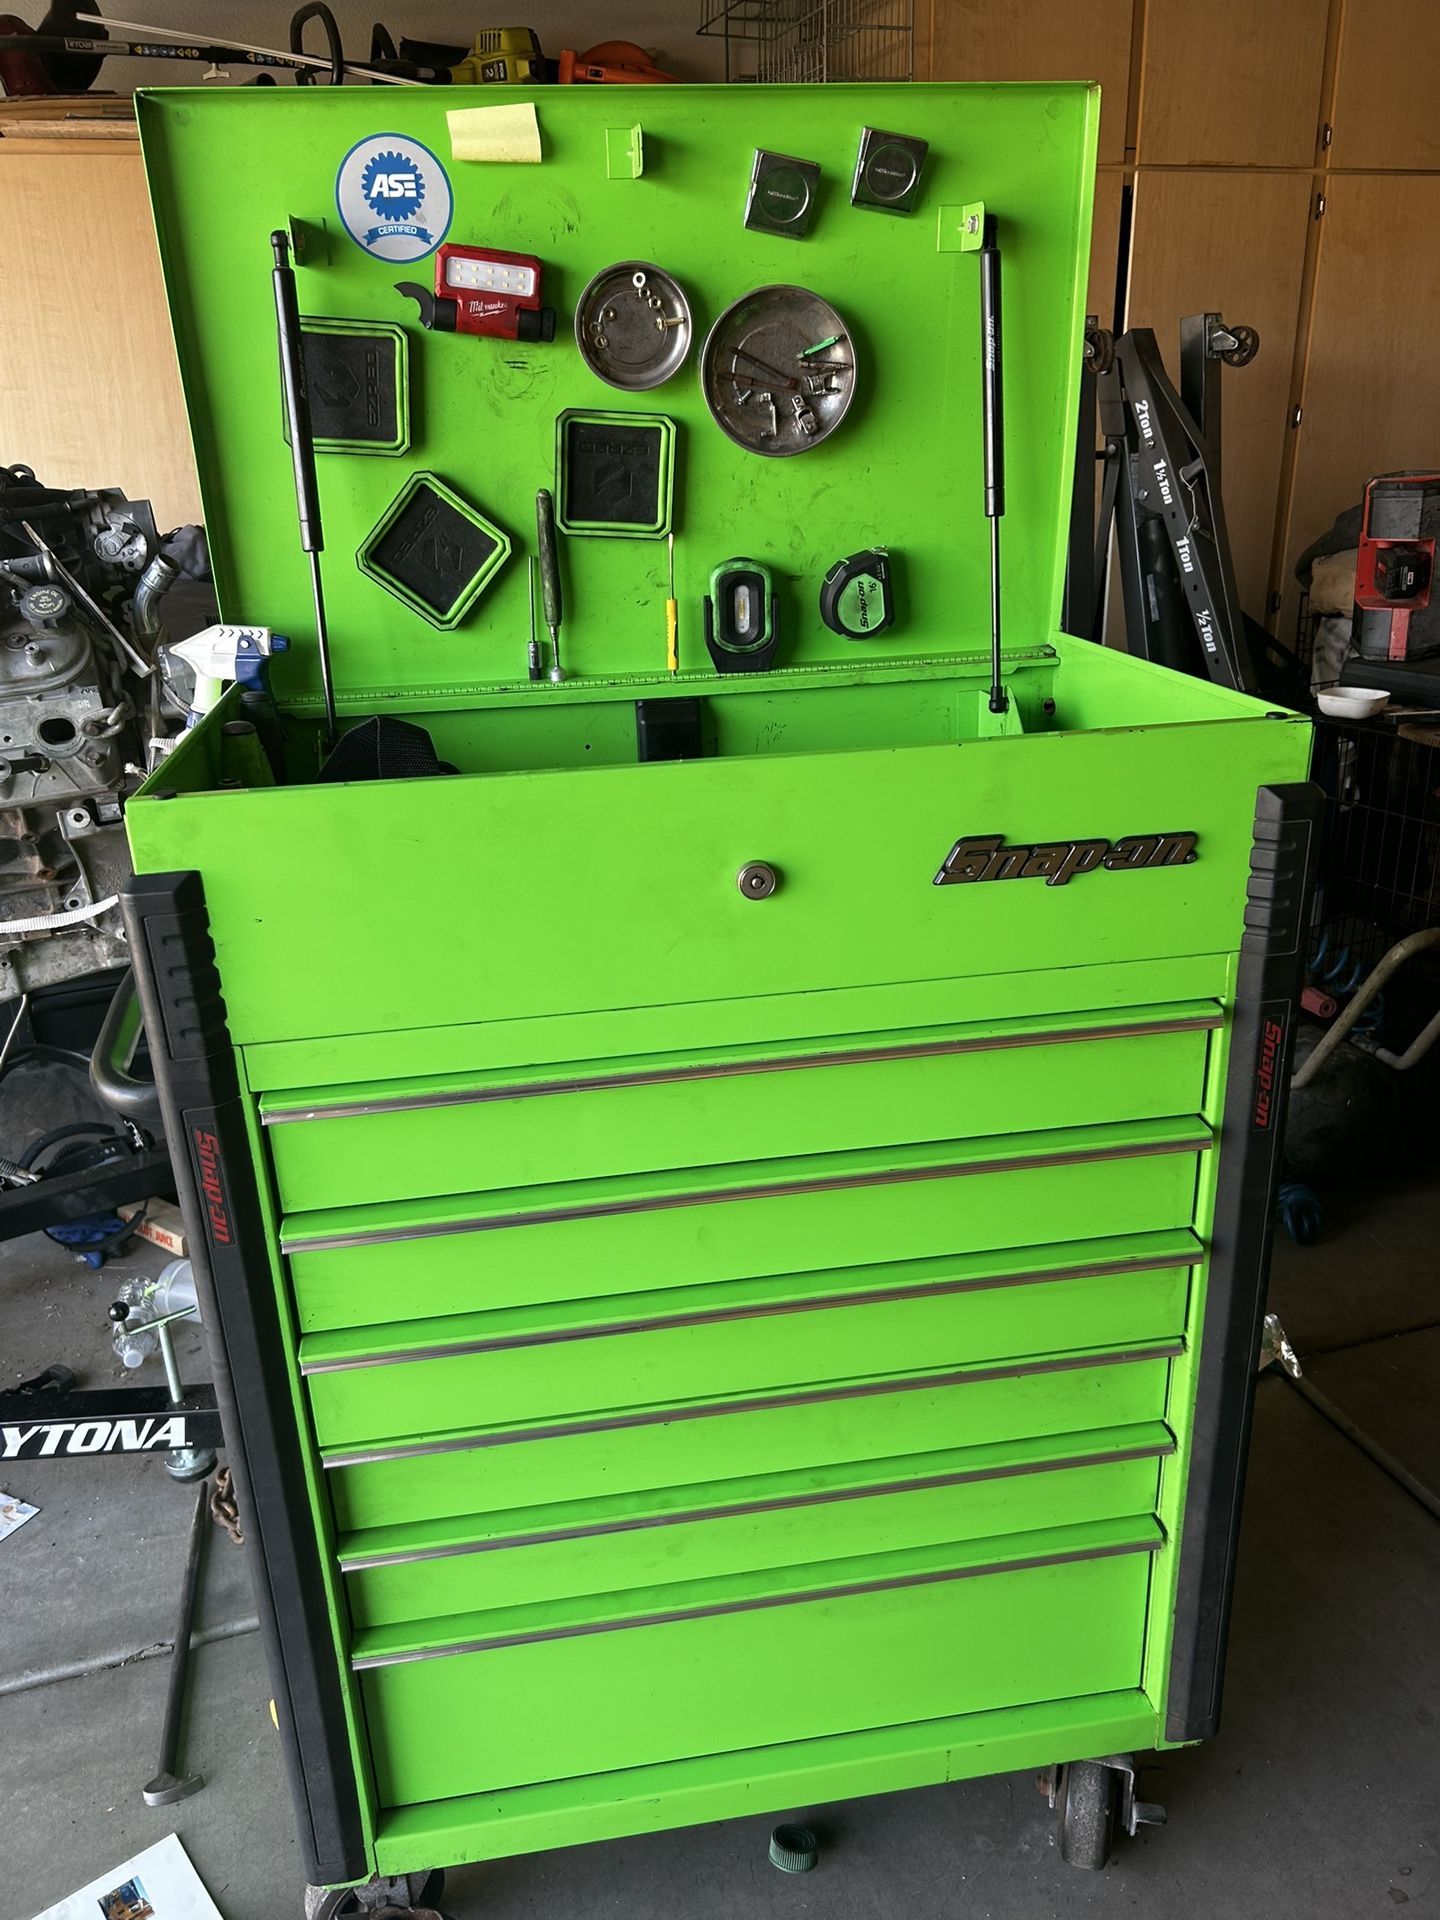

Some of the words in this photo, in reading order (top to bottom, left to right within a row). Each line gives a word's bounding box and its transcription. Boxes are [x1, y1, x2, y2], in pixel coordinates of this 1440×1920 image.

[370, 174, 417, 198] ASE
[378, 226, 417, 235] CERTIFIED
[857, 581, 869, 629] Snap-on
[933, 832, 1199, 886] Snap-on
[1255, 1020, 1282, 1127] Snap-on
[195, 1128, 231, 1243] Snap-on
